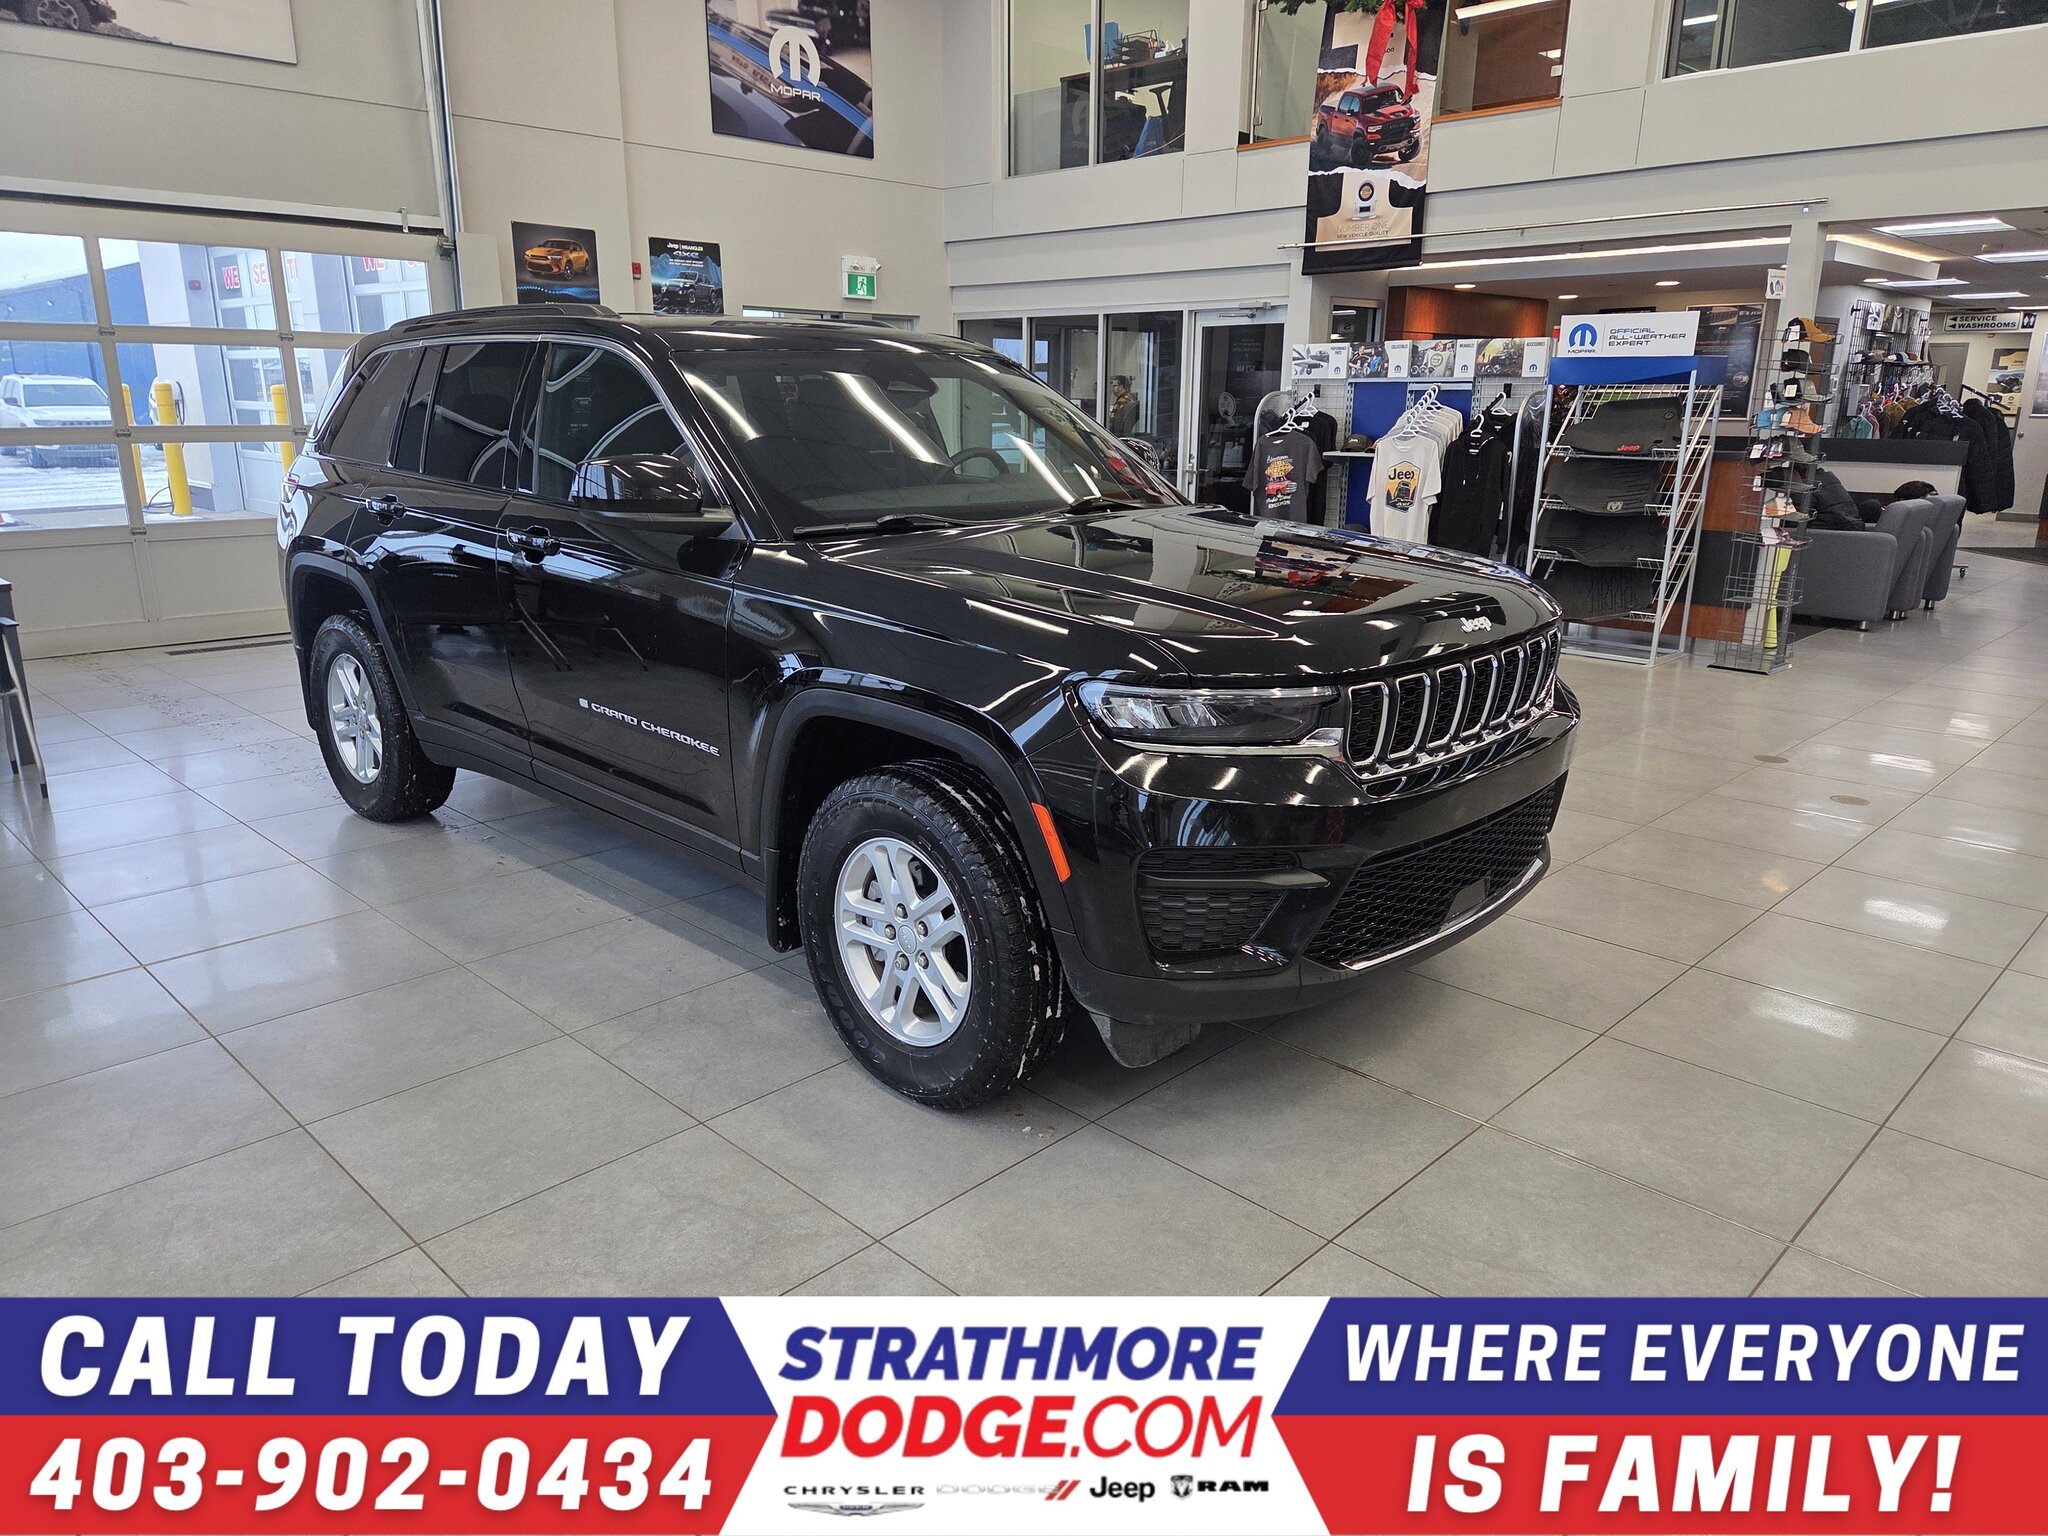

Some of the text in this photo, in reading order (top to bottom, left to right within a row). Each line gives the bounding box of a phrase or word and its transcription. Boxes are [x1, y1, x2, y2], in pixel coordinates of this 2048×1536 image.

[770, 83, 822, 102] MOPAR
[1336, 220, 1390, 232] NUMBER ONE
[222, 265, 240, 290] WE
[1616, 444, 1641, 452] Jeep
[1459, 616, 1492, 633] Jeep
[590, 702, 721, 757] GRAND CHEROKEE
